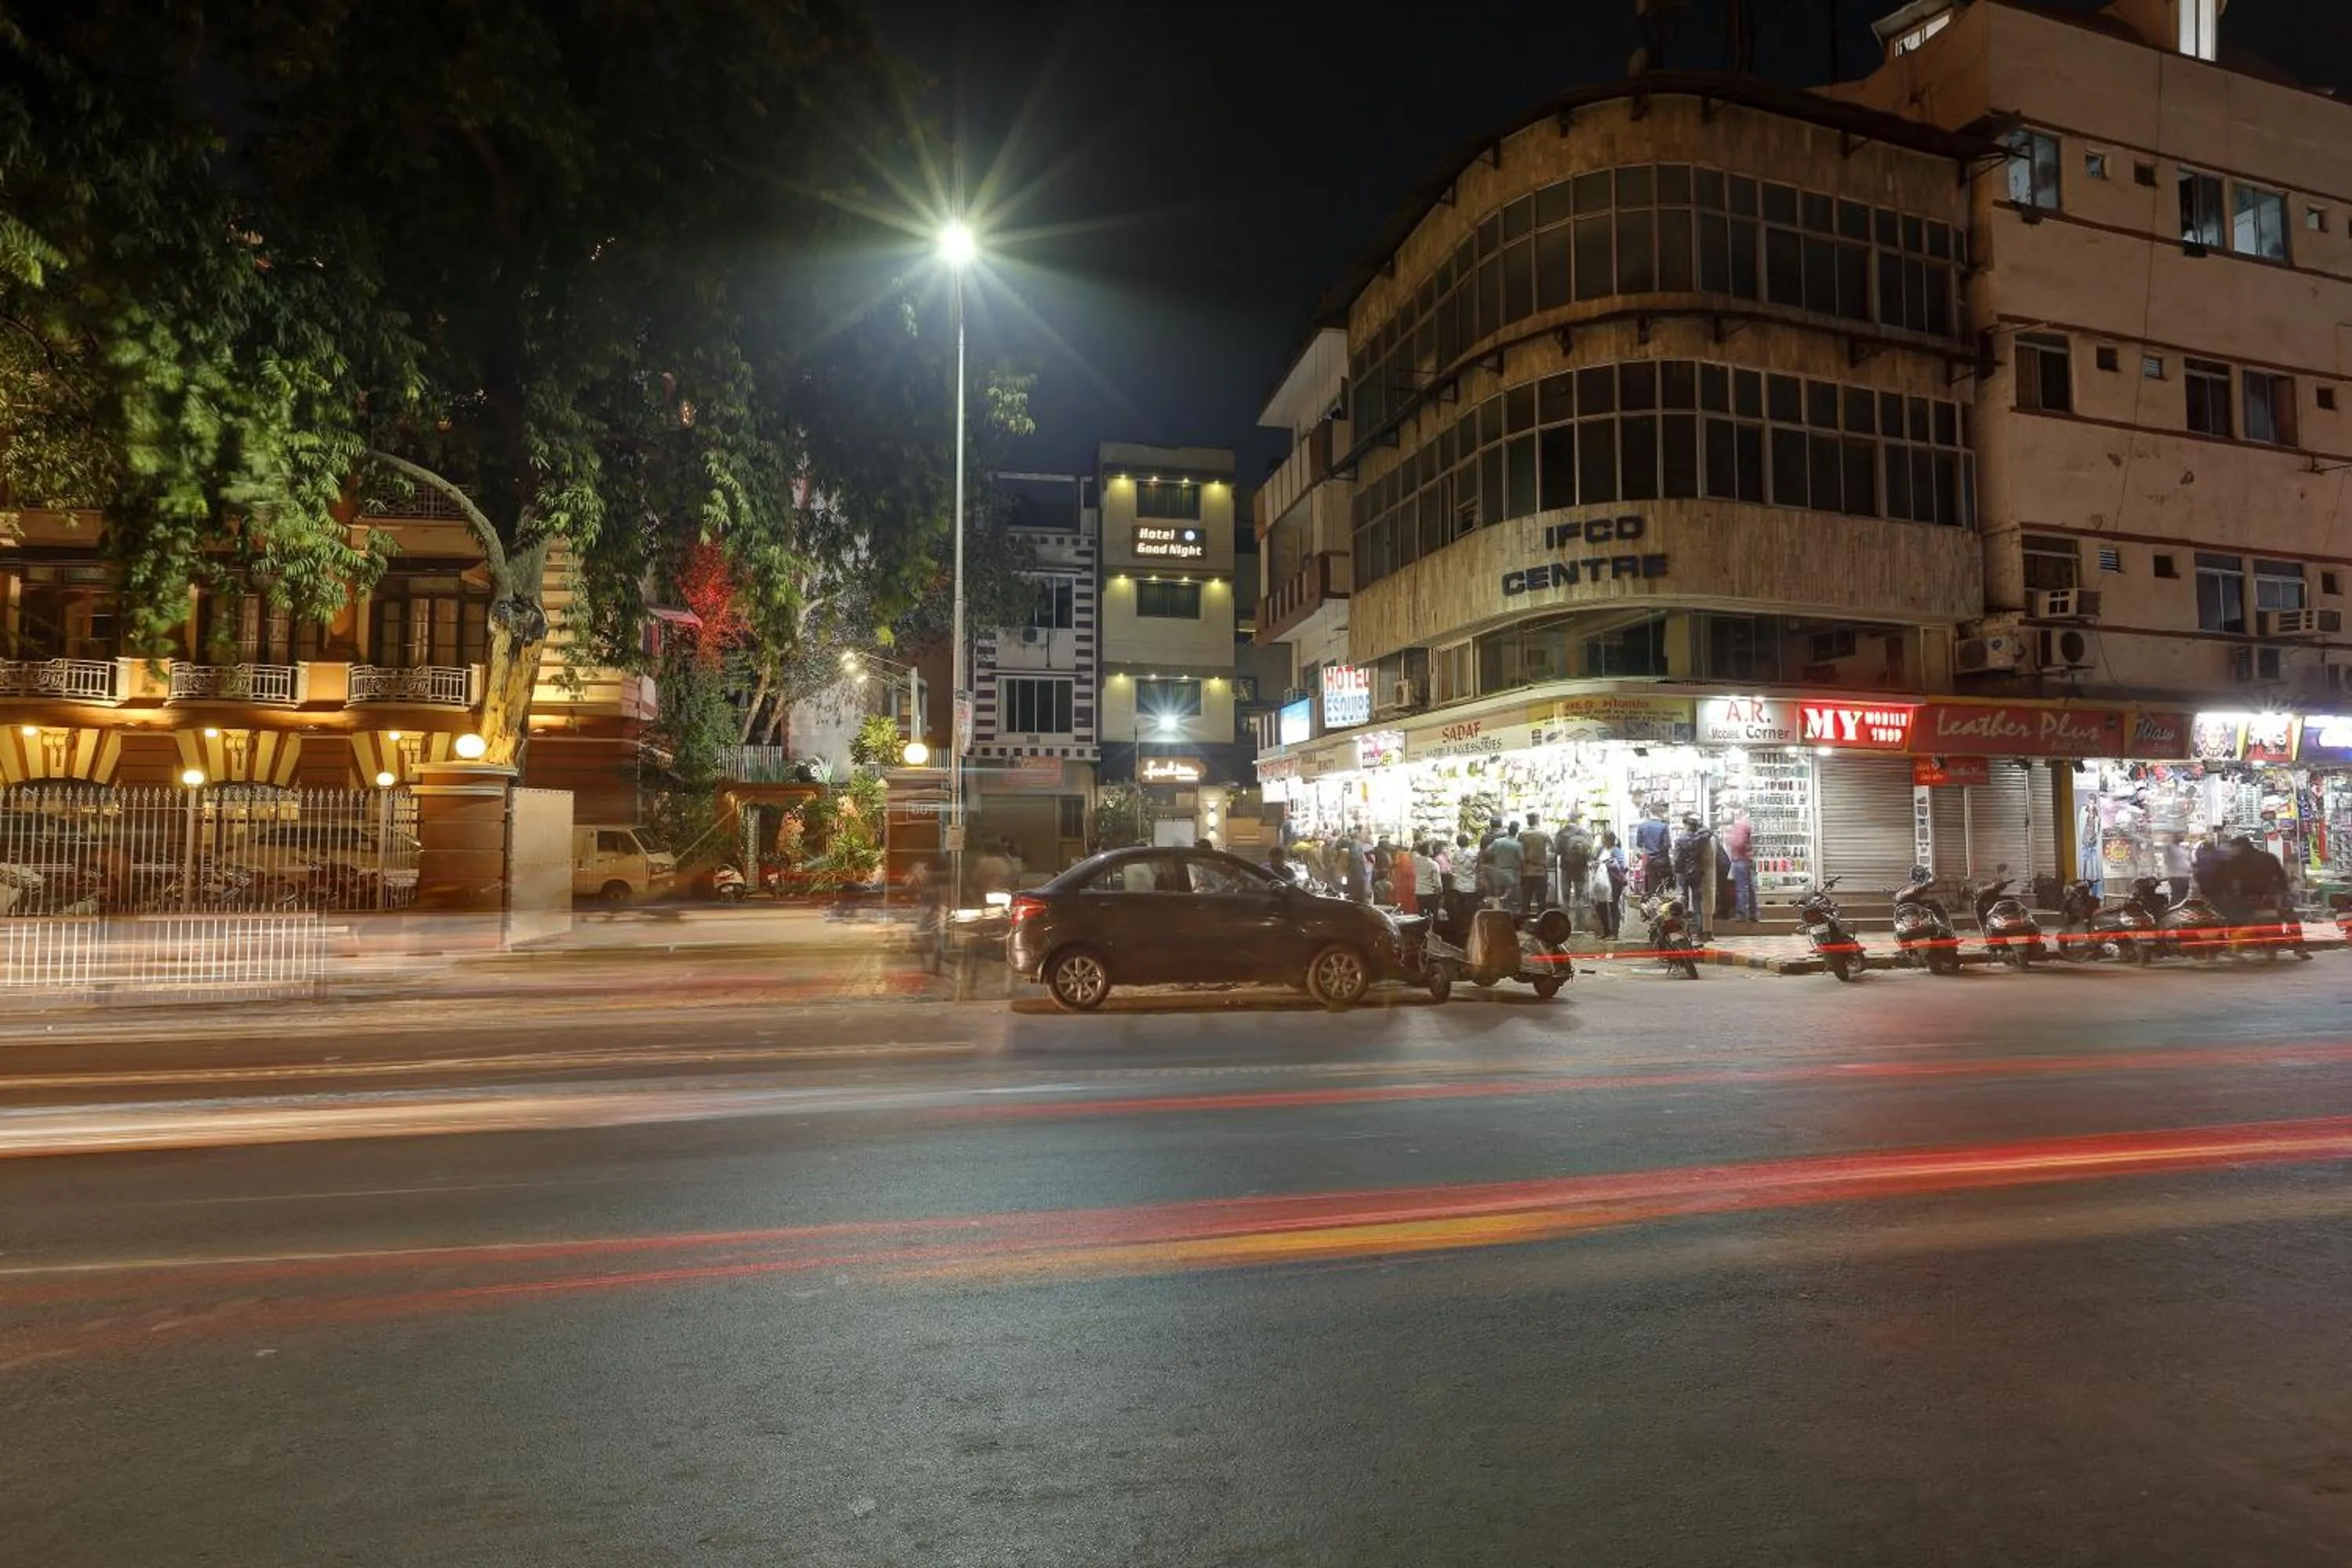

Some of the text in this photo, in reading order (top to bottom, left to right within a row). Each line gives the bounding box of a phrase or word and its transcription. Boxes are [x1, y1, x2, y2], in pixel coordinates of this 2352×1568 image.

[1139, 528, 1175, 540] Hotel
[1545, 515, 1644, 550] IFCO
[1137, 542, 1202, 557] Good Night
[1502, 554, 1668, 597] CENTRE
[1326, 666, 1371, 691] HOTEL
[1442, 721, 1481, 744] SADAF
[1745, 724, 1791, 740] Corner
[1804, 707, 1907, 741] MY MOBILE
[1871, 728, 1902, 742] SHOP
[1936, 709, 2100, 741] Leather Plus
